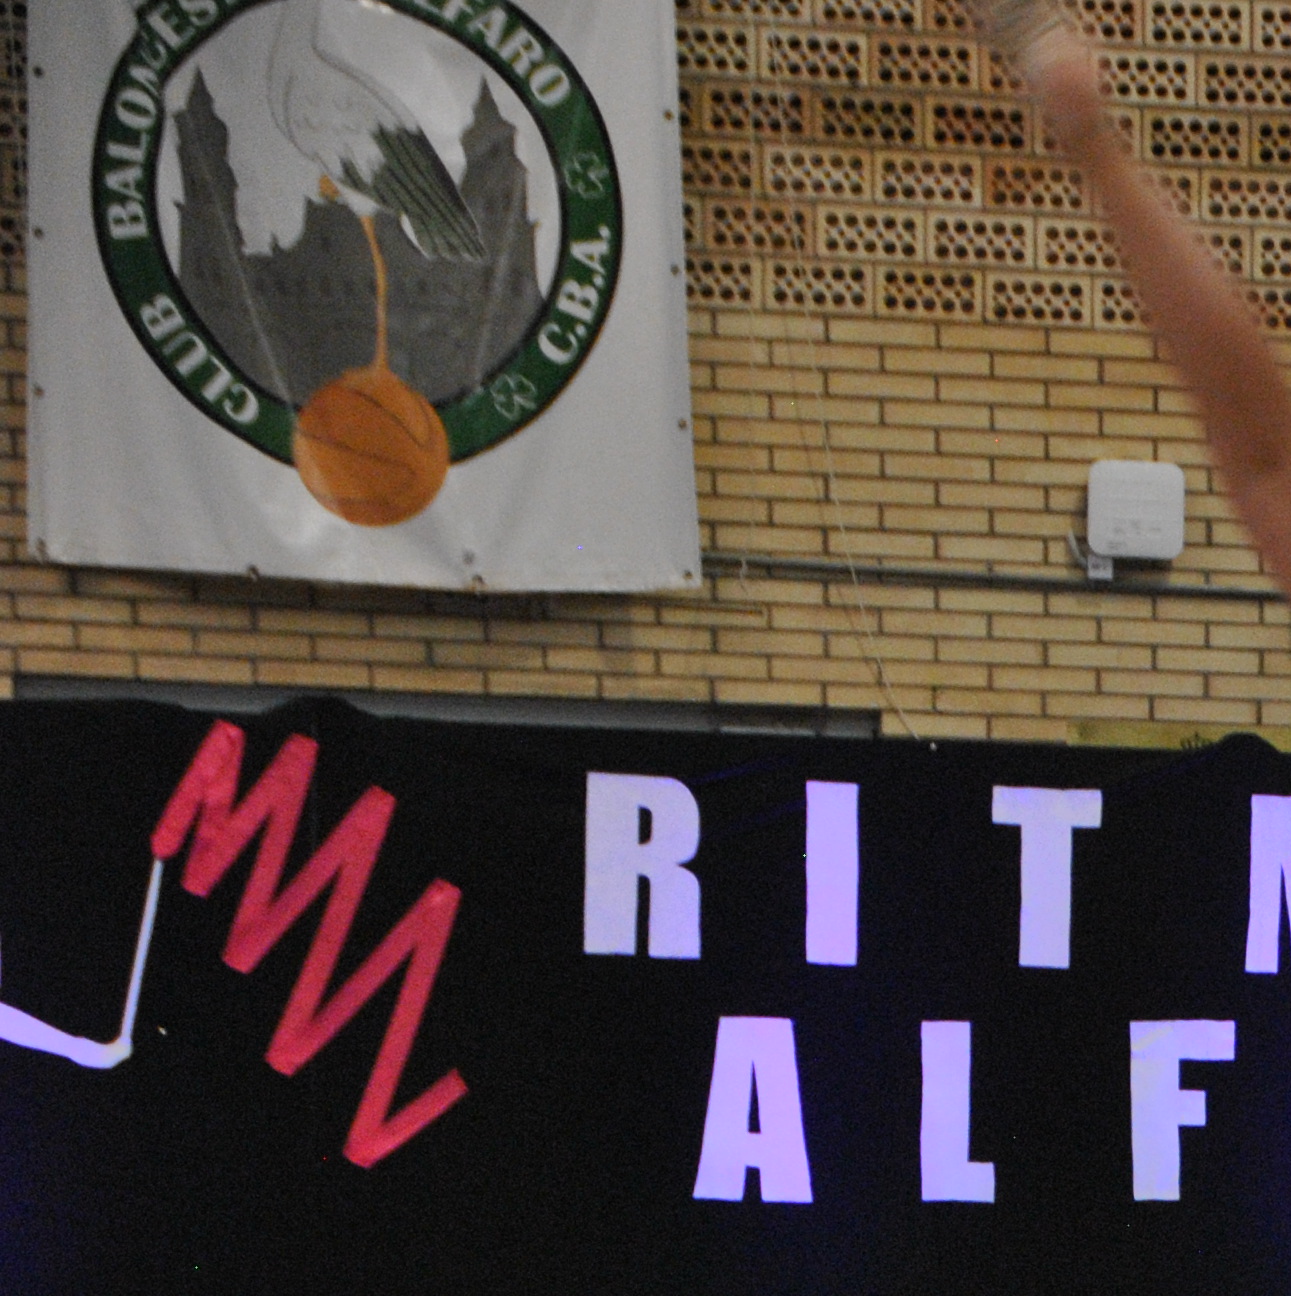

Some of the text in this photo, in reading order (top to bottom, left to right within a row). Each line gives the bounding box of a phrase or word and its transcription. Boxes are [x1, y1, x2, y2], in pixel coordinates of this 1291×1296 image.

[104, 0, 220, 240] BALONCES
[139, 293, 260, 424] CLUB
[694, 1015, 1236, 1202] ALF
